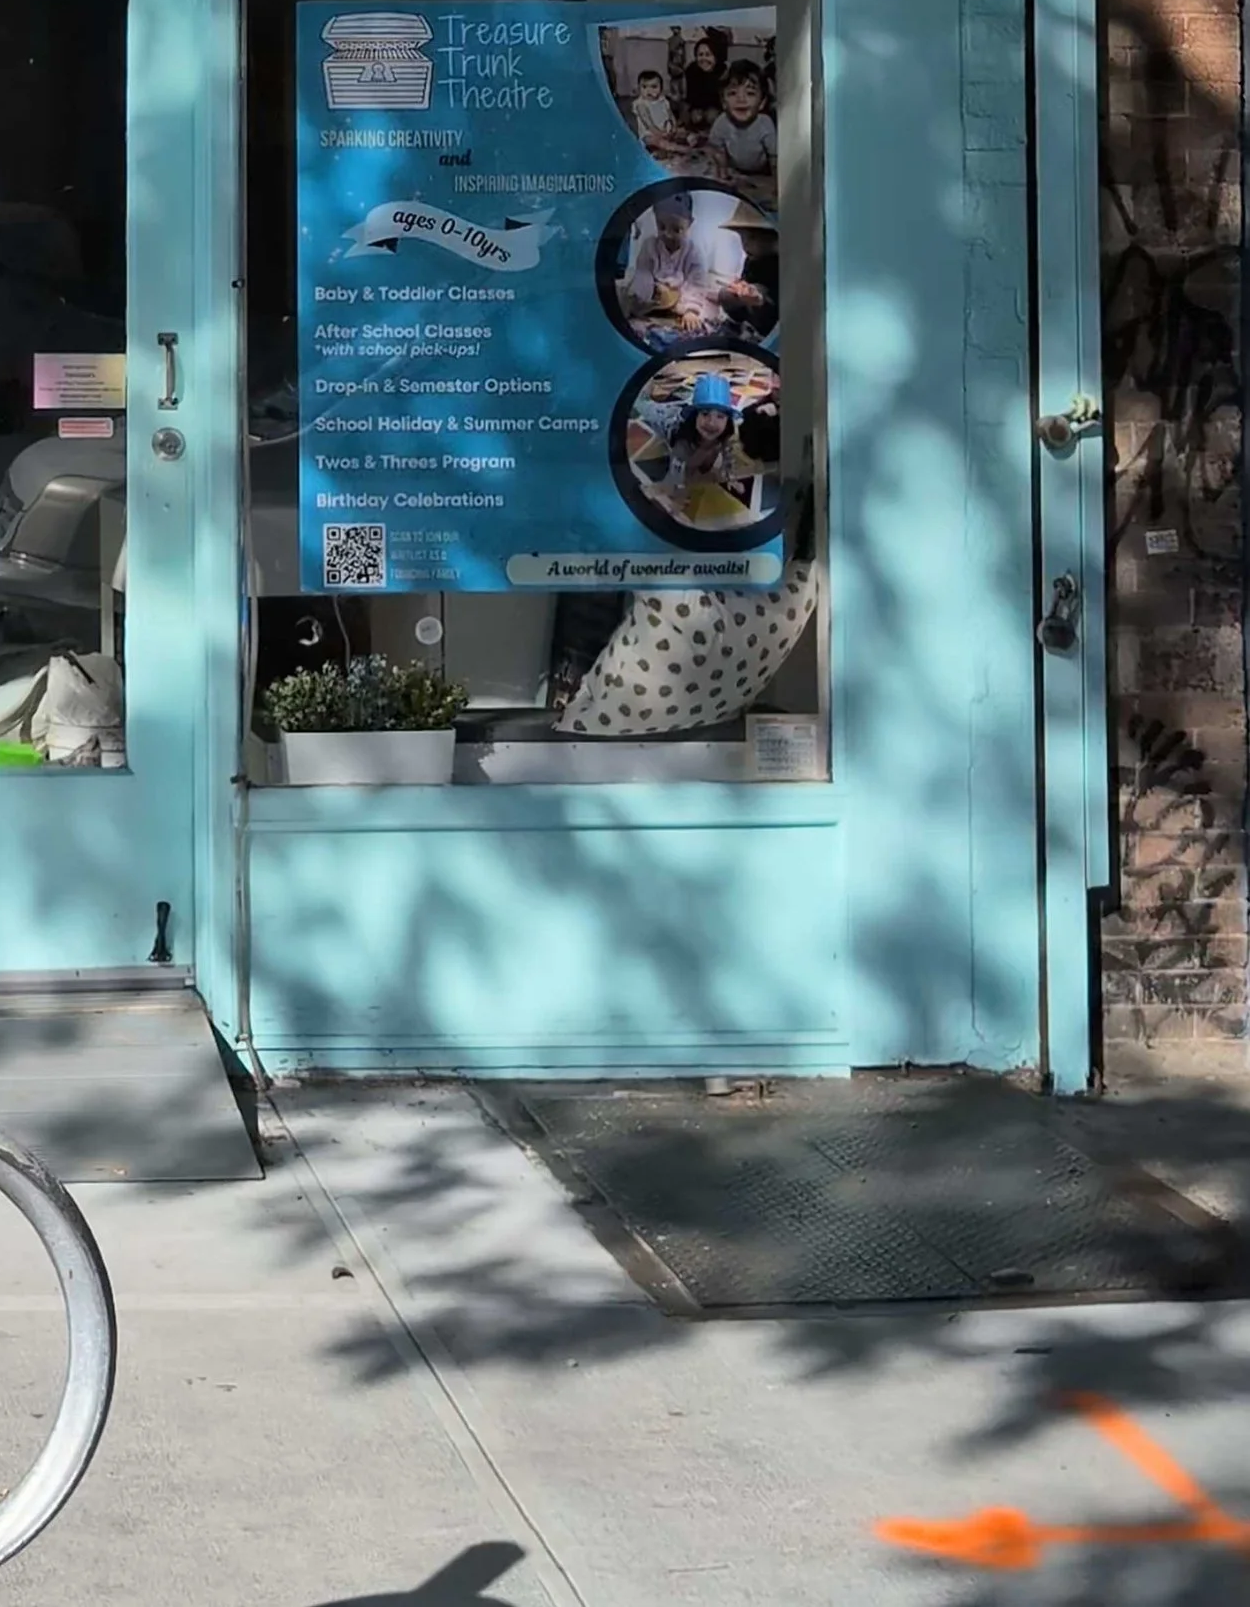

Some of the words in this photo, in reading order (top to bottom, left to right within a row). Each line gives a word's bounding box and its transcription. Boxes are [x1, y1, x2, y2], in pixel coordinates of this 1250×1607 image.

[438, 14, 572, 45] Treasure
[438, 47, 524, 78] Trunk
[438, 79, 554, 110] Theatre
[319, 130, 385, 148] SPARKING
[388, 130, 464, 148] CREATIVITY
[438, 149, 472, 167] and
[454, 175, 518, 193] INSPIRING
[521, 175, 615, 193] IMAGINATIONS
[392, 209, 436, 232] ages
[441, 217, 512, 264] 0-10yrs
[315, 286, 357, 304] Baby
[362, 287, 375, 301] &
[378, 286, 444, 301] Toddler
[448, 286, 515, 301] Classes
[314, 324, 358, 339] After
[361, 324, 420, 339] School
[424, 324, 492, 339] Classes
[357, 342, 407, 356] school
[410, 342, 481, 360] pick-ups!
[315, 378, 379, 397] Drop-in
[383, 379, 396, 393] &
[399, 378, 481, 393] Semester
[484, 378, 552, 396] Options
[315, 416, 373, 432] School
[377, 416, 443, 435] Holiday
[447, 417, 459, 431] &
[463, 416, 535, 431] Summer
[538, 416, 600, 434] Camps
[315, 454, 360, 469] Twos
[364, 455, 376, 469] &
[380, 454, 437, 469] Threes
[442, 454, 516, 473] Program
[315, 492, 389, 511] Birthday
[393, 492, 504, 508] Celebrations
[546, 559, 560, 576] A
[563, 559, 609, 576] world
[612, 559, 630, 581] of
[631, 559, 690, 576] wonder
[693, 559, 750, 576] awaits!
